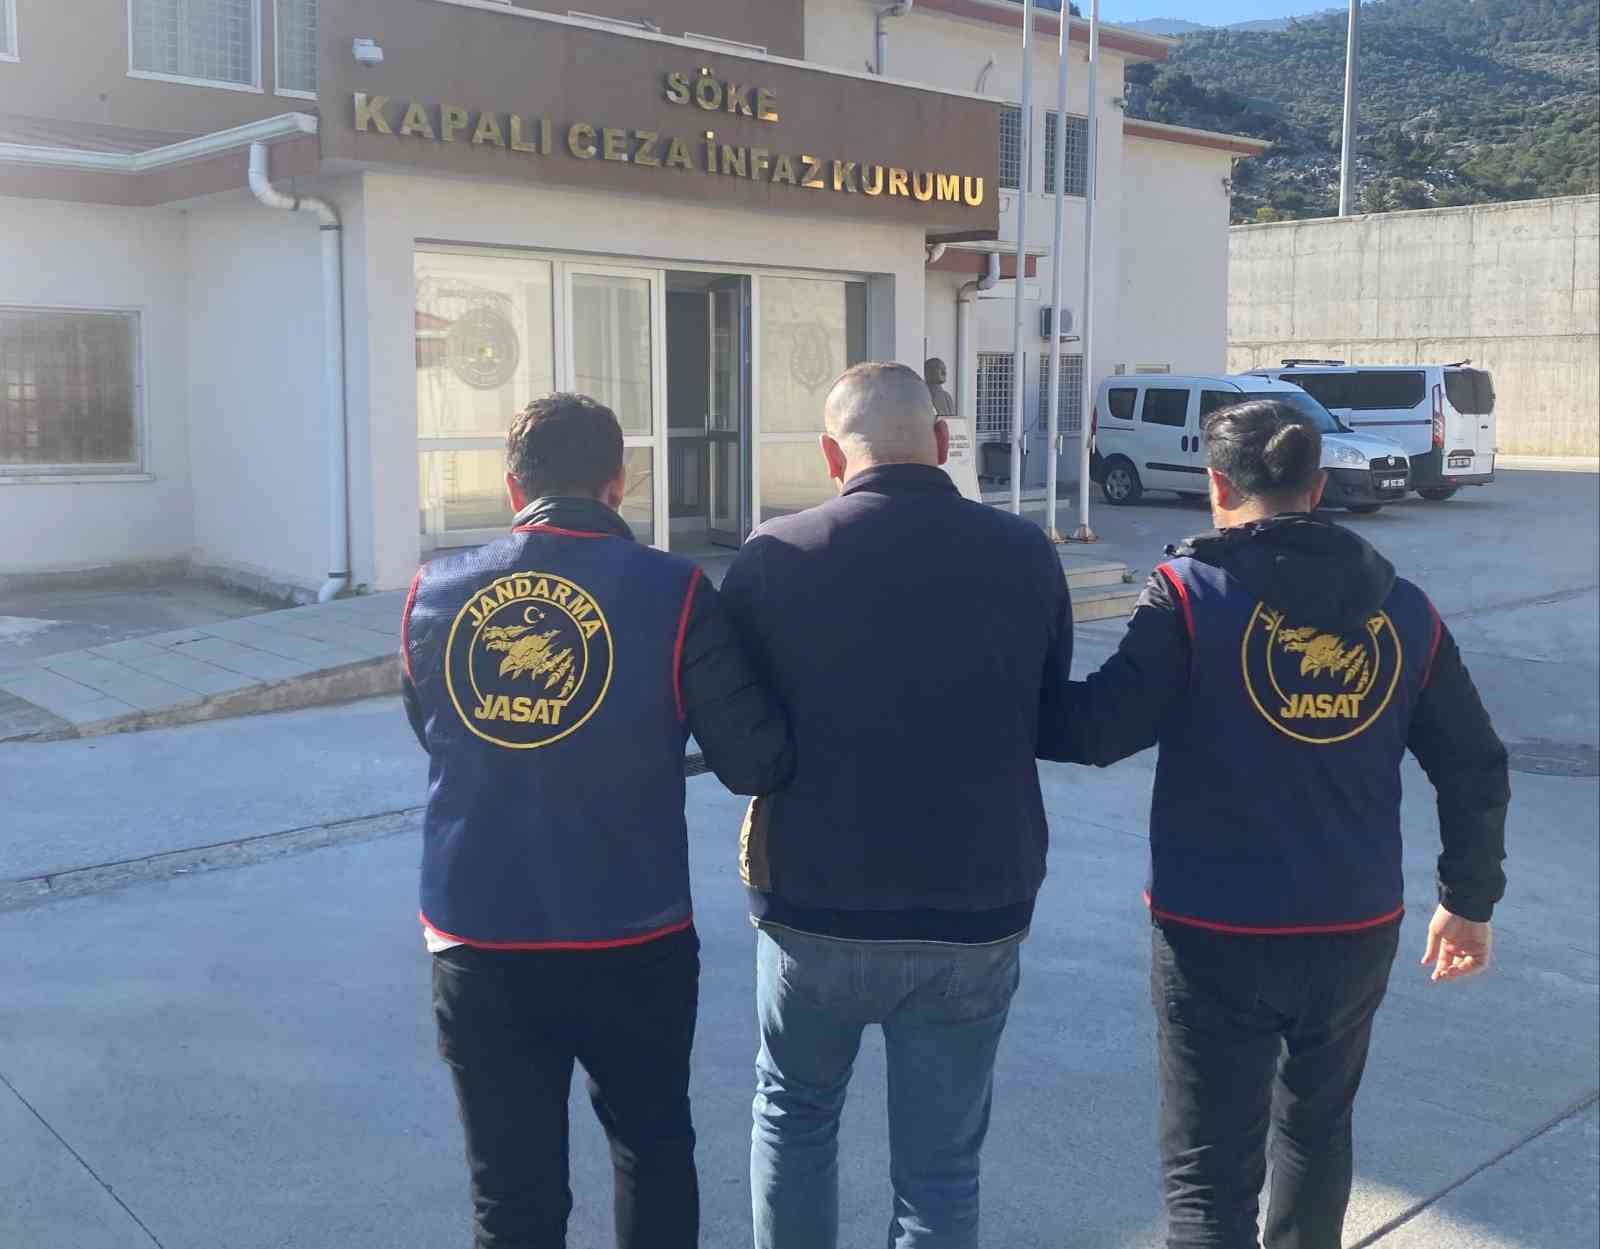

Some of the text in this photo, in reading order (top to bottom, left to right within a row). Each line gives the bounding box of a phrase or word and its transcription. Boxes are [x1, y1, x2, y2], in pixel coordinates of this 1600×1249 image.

[665, 67, 779, 122] SÖKE
[353, 92, 984, 206] KAPALI CEZA İNFAZ KURUMU
[467, 578, 602, 640] JANDARMA
[474, 694, 568, 725] JASAT
[1280, 693, 1364, 718] JASAT
